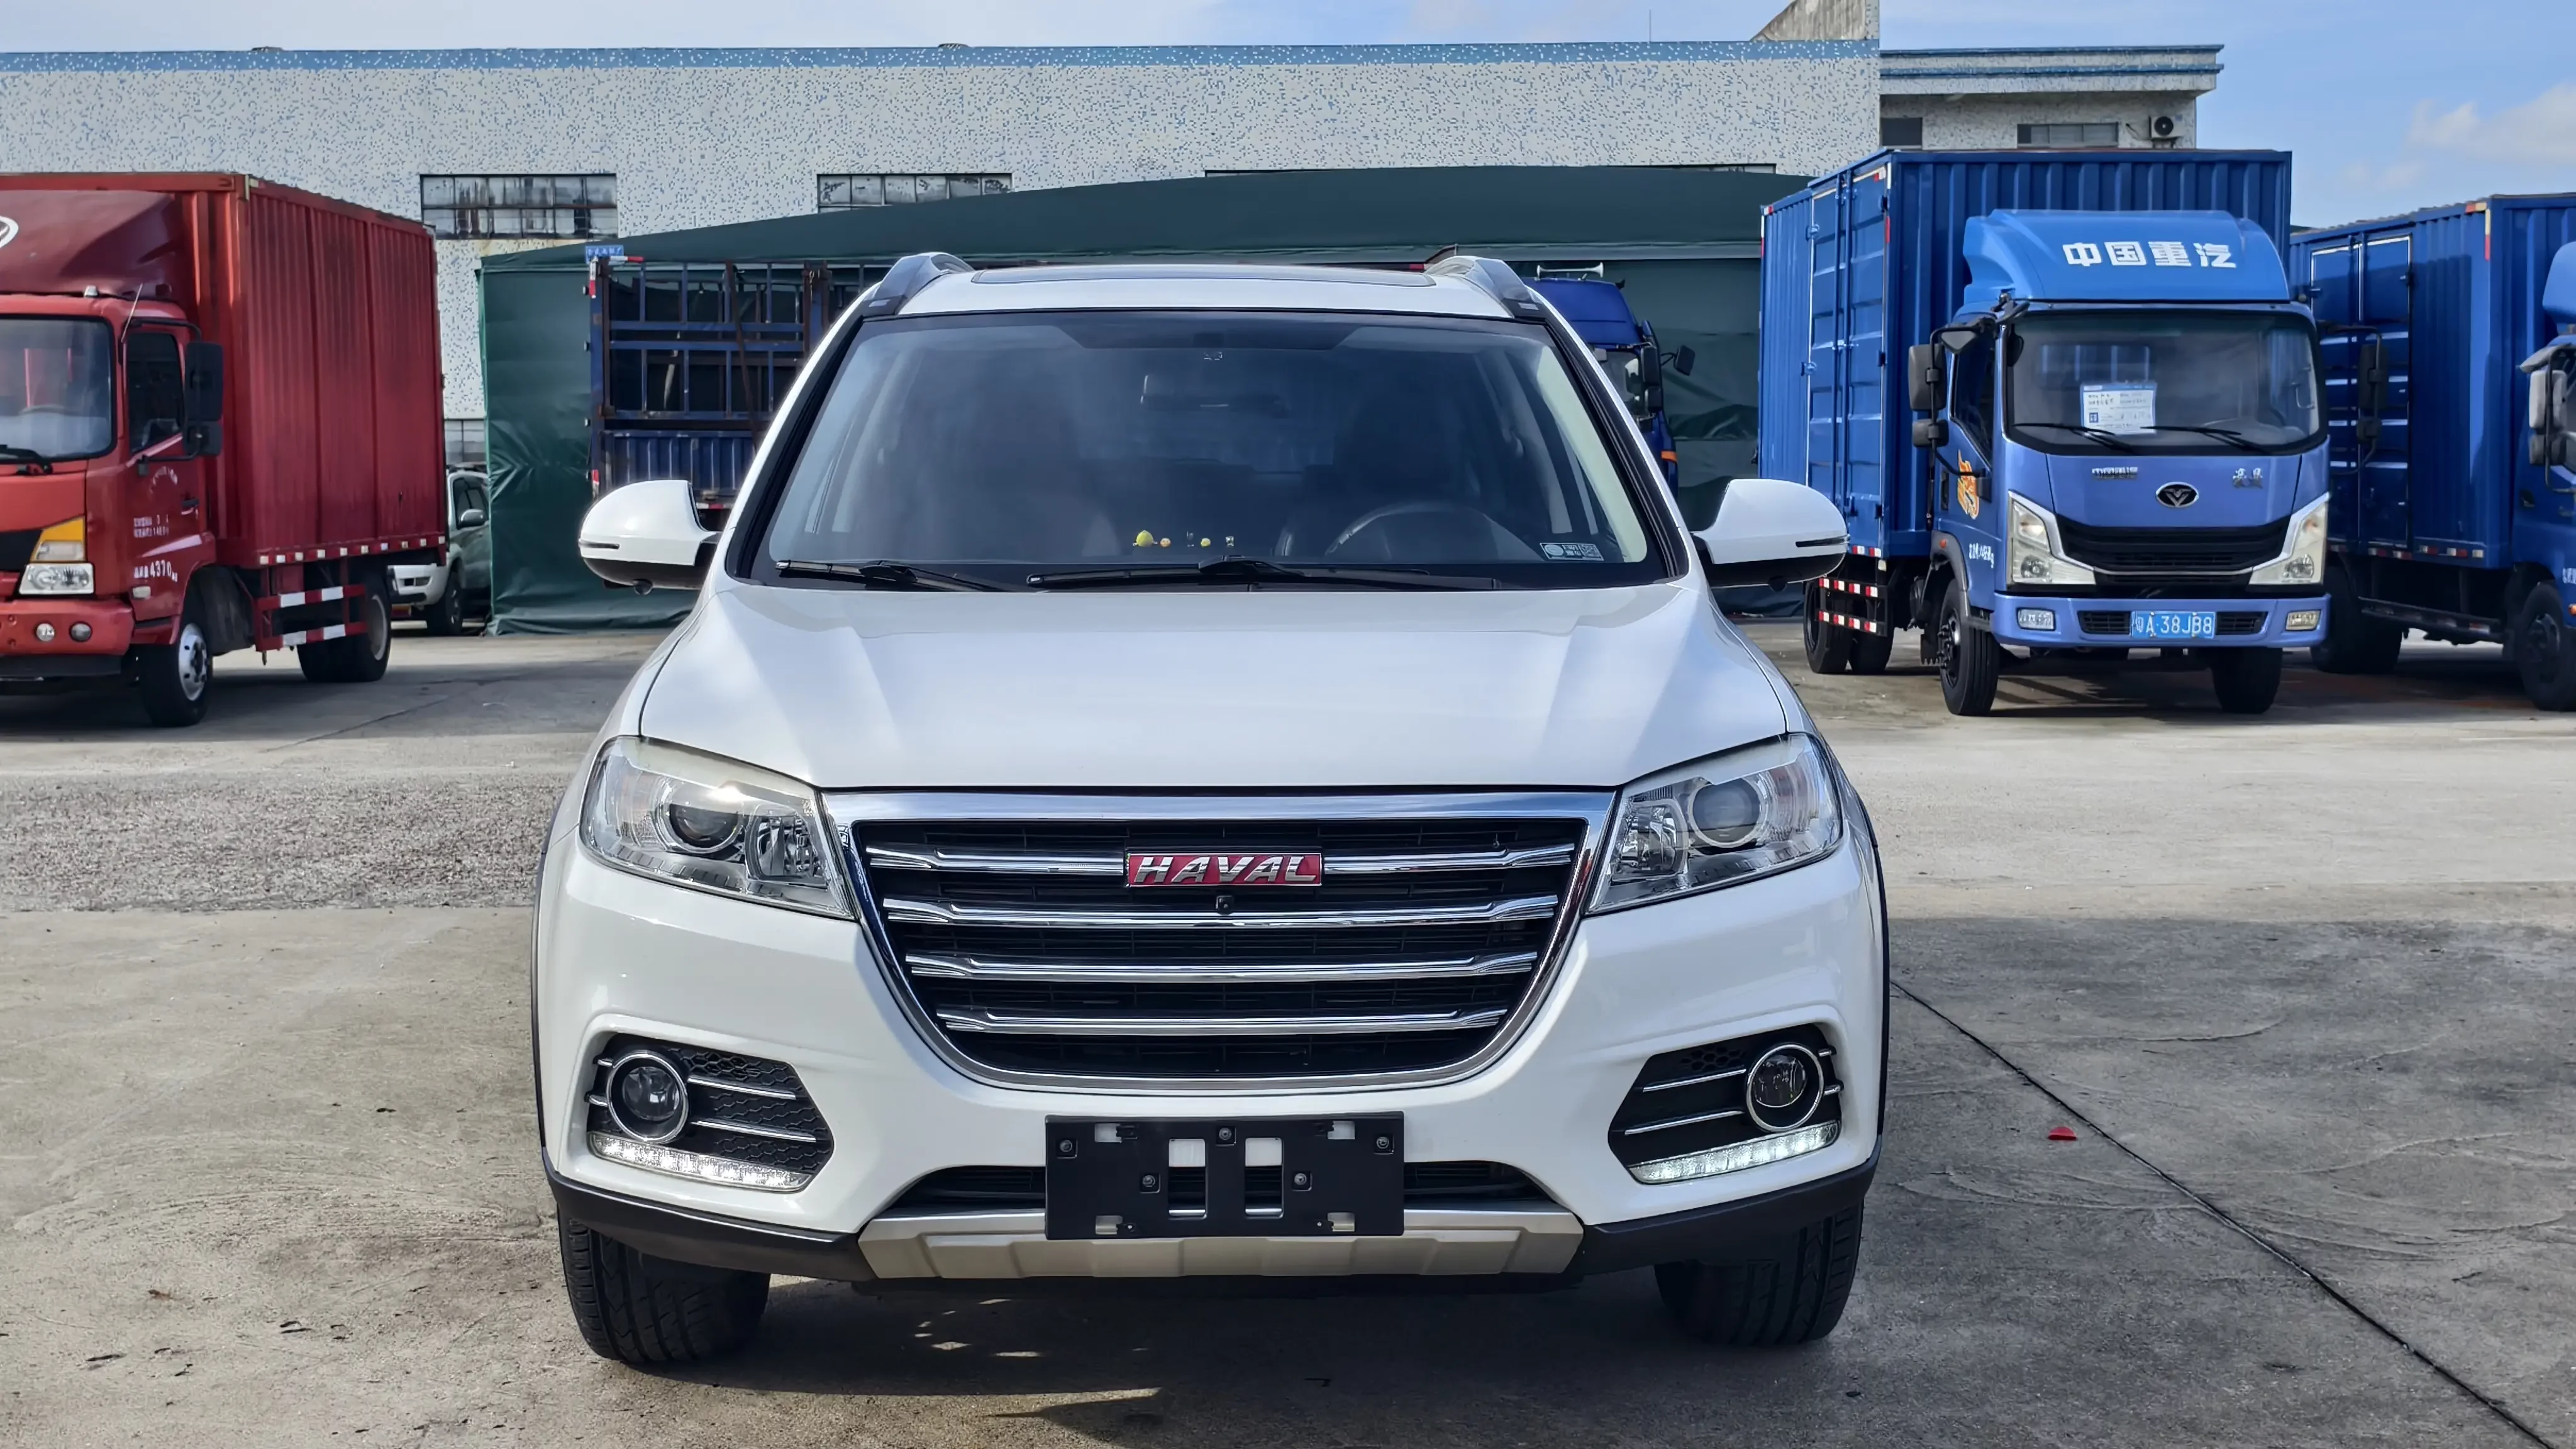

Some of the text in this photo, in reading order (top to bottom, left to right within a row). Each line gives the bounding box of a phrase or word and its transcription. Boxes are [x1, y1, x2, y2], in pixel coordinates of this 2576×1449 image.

[2062, 242, 2236, 268] 中国重汽
[1133, 857, 1317, 882] HAVAL
